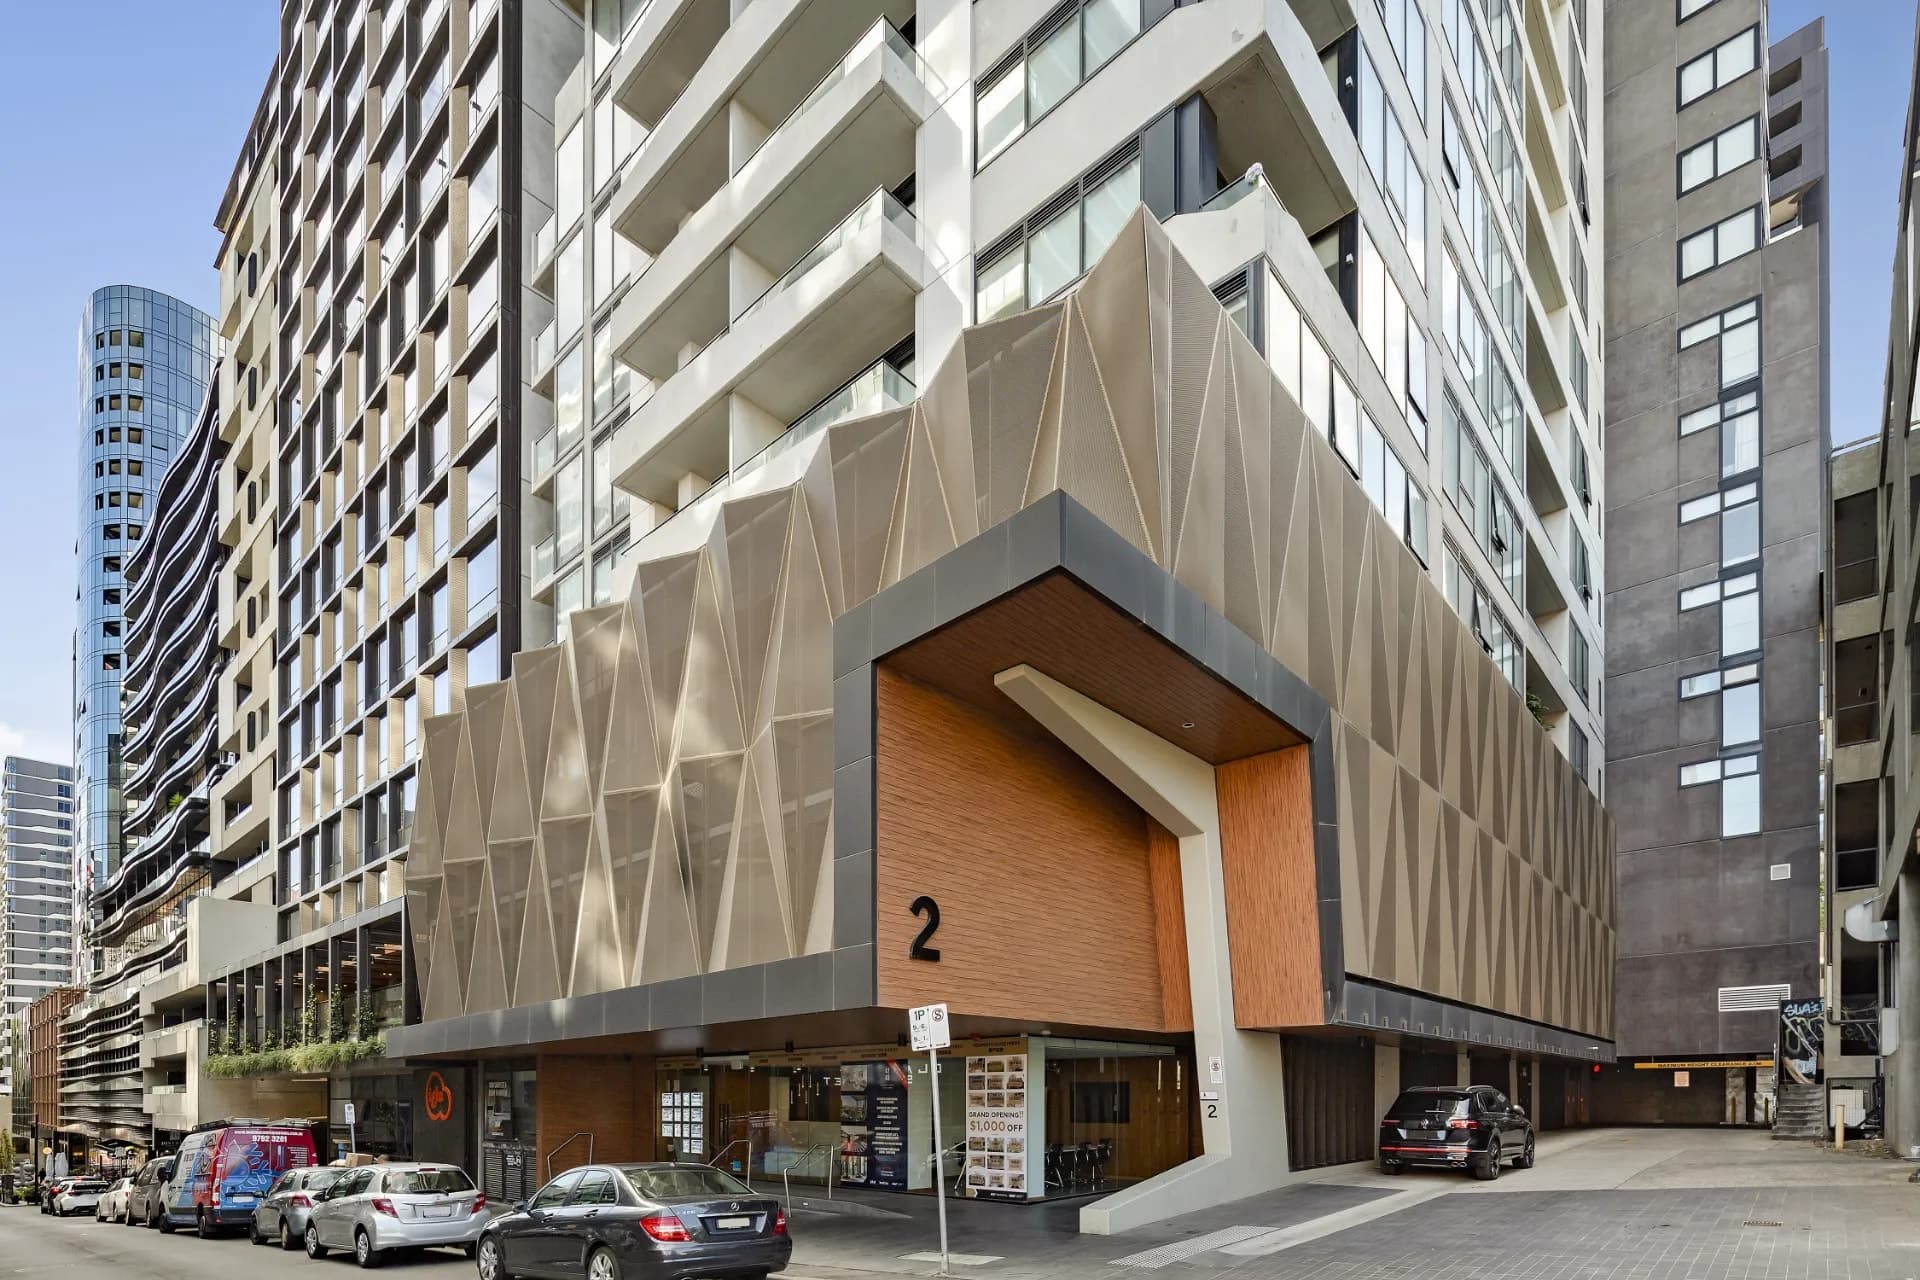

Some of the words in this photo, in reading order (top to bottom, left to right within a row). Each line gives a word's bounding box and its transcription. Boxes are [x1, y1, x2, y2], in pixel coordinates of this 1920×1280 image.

[909, 895, 941, 962] 2
[914, 1009, 925, 1021] 1P
[968, 1111, 990, 1119] GRAND
[1207, 1104, 1218, 1119] 2
[969, 1120, 1006, 1133] $1,000
[1006, 1124, 1024, 1133] OFF
